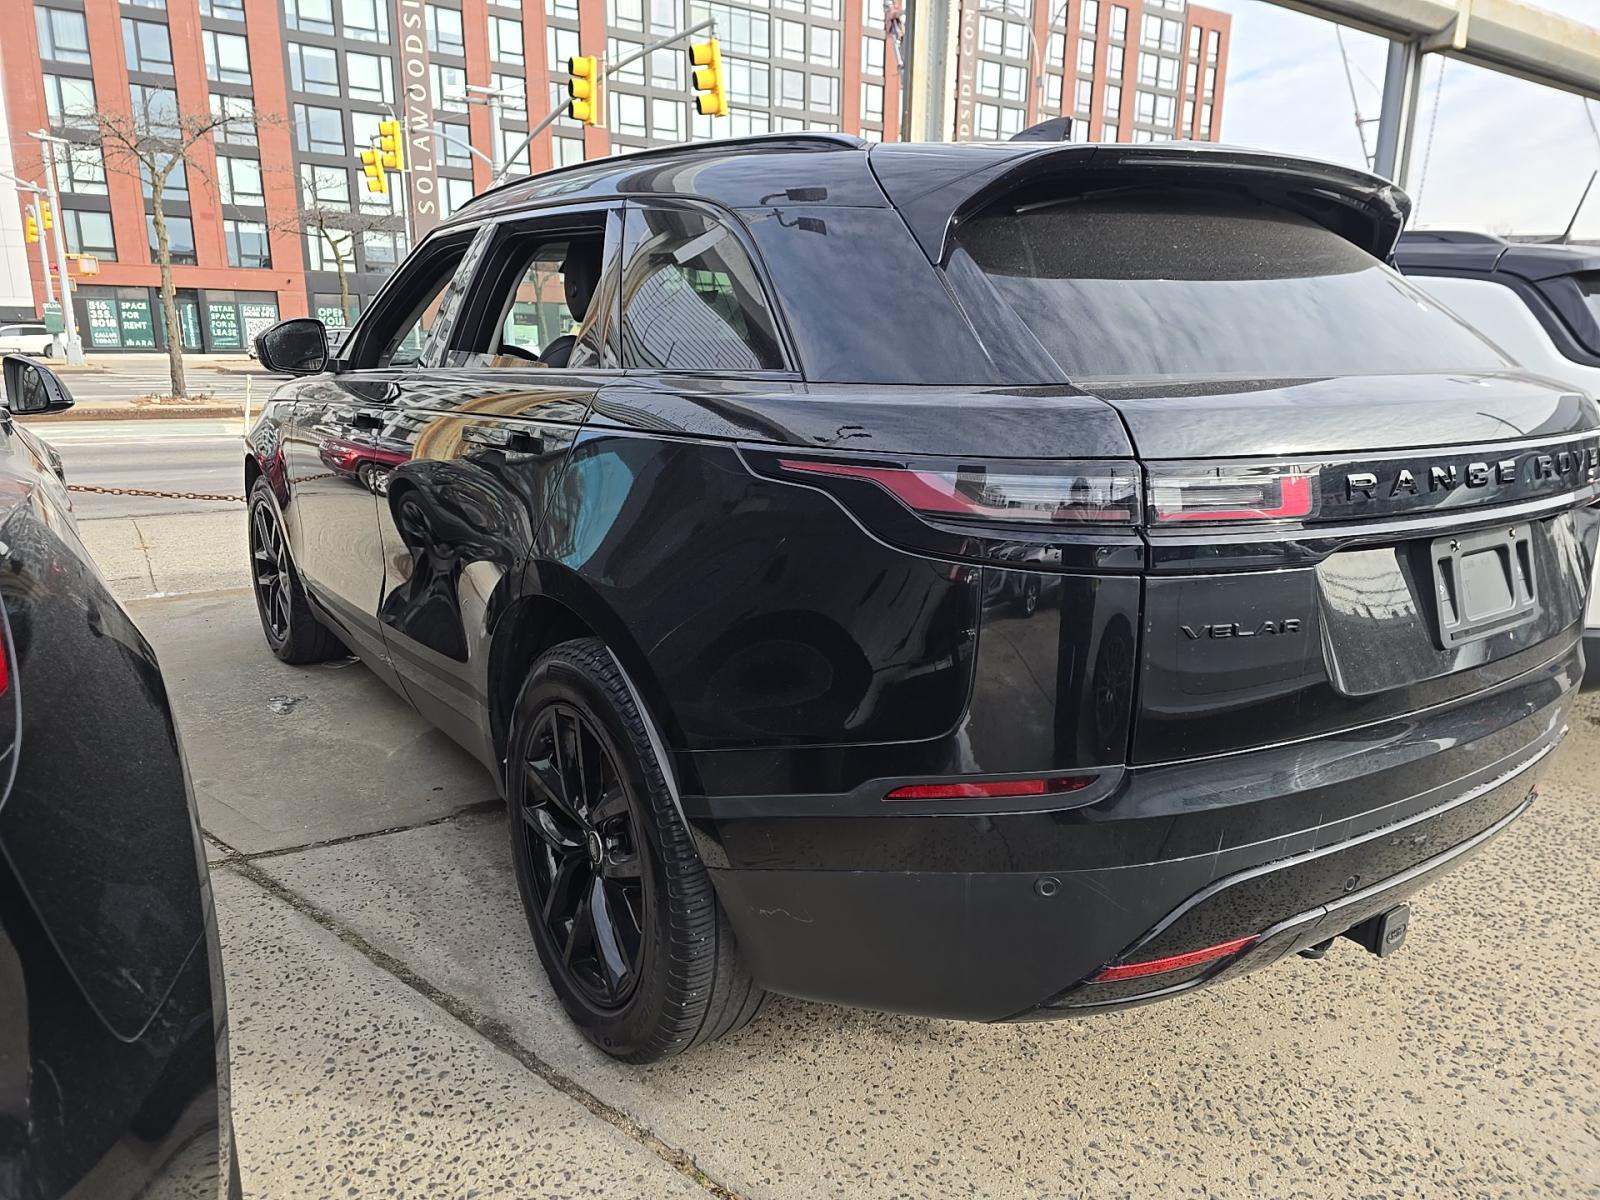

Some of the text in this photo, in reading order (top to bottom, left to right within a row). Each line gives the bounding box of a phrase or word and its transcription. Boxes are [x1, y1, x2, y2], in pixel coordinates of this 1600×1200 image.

[960, 9, 975, 143] DSIDE.COM
[121, 302, 147, 310] SPACE
[123, 321, 147, 329] RENT
[1346, 460, 1516, 501] RANGE
[1181, 619, 1301, 640] VELAR
